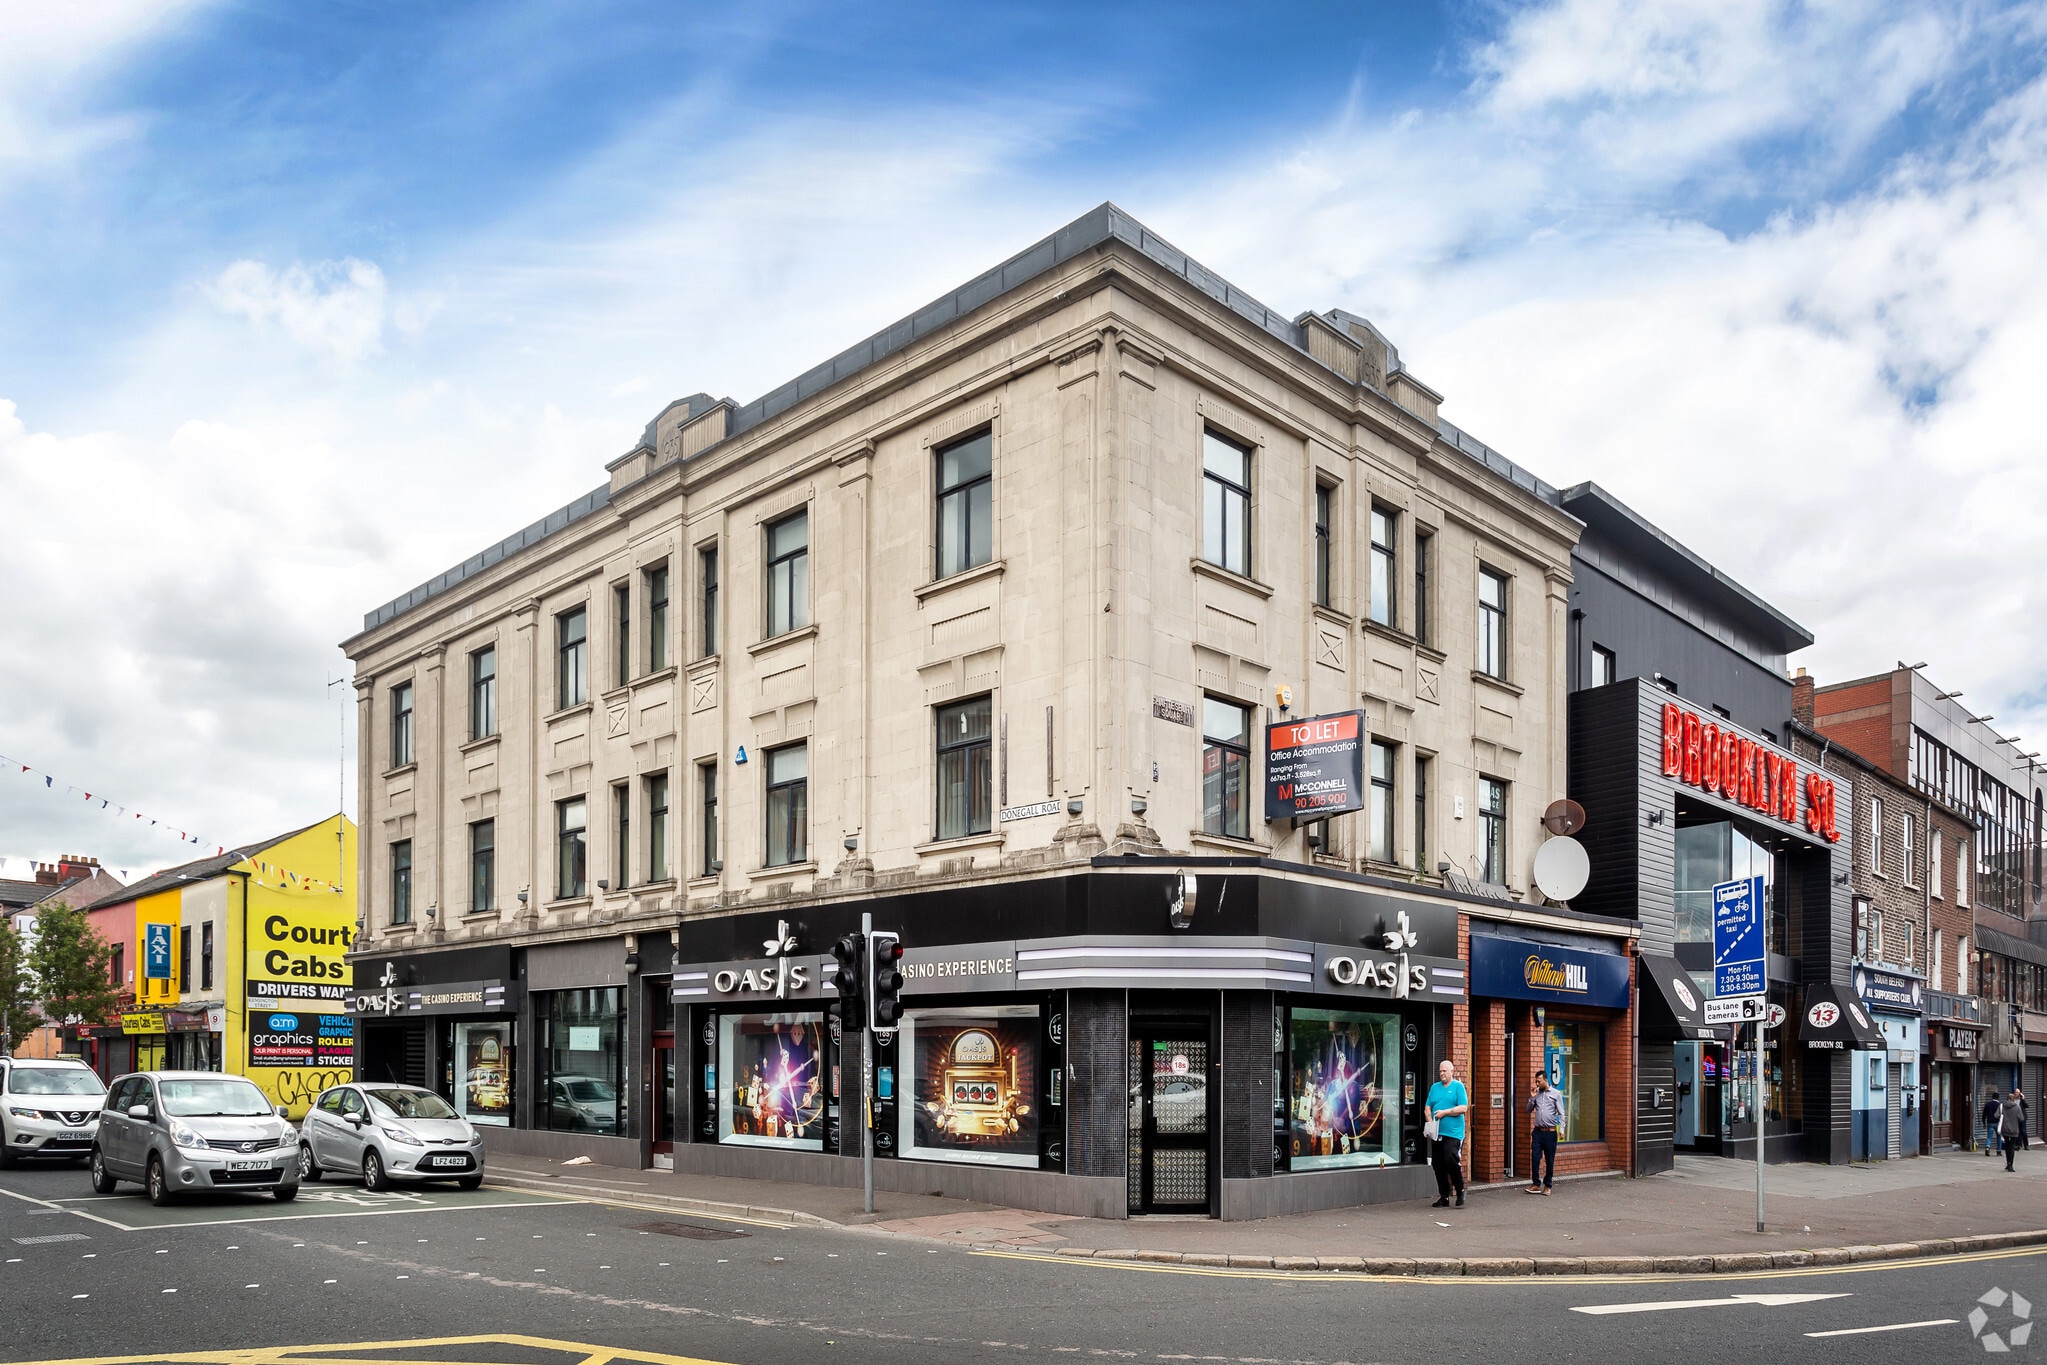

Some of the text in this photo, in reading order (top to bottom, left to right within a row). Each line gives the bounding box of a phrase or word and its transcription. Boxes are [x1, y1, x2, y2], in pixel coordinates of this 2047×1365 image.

[1291, 721, 1340, 743] TO LET
[1270, 742, 1357, 761] Office Accommodation
[1270, 762, 1308, 774] Ranging From
[1662, 702, 1797, 823] BROOKLYN
[1294, 797, 1307, 809] 90
[1308, 794, 1327, 807] 205
[1328, 792, 1347, 804] 900
[1001, 806, 1039, 820] DONEGALL
[1717, 914, 1746, 927] permitted
[264, 915, 357, 946] Court
[1726, 924, 1737, 933] taxi
[150, 926, 168, 964] TAXI
[264, 950, 344, 979] Cabs
[937, 959, 1013, 977] EXPERIENCE
[1727, 965, 1751, 975] Mon-Fri
[715, 957, 808, 999] OASIS
[1324, 953, 1427, 999] OASIS
[1524, 955, 1588, 990] William HILL
[1720, 973, 1760, 984] 7.30-9.30am
[1720, 982, 1760, 993] 3.30-6.30pm
[1874, 973, 1905, 988] SOUTH BELFAST
[257, 983, 317, 997] DRIVERS
[1874, 989, 1901, 1002] SUPPORTERS
[1901, 993, 1911, 1004] CLUB
[356, 988, 402, 1016] OASIS
[421, 992, 482, 1004] THE CASINO EXPERIENCE
[1723, 1002, 1739, 1010] lane
[1707, 1011, 1739, 1019] cameras
[1815, 1010, 1834, 1021] 13
[253, 1032, 314, 1046] graphics
[318, 1038, 354, 1046] ROLLER
[1808, 1040, 1834, 1048] BROOKLYN
[231, 1160, 269, 1169] WEZ 7177
